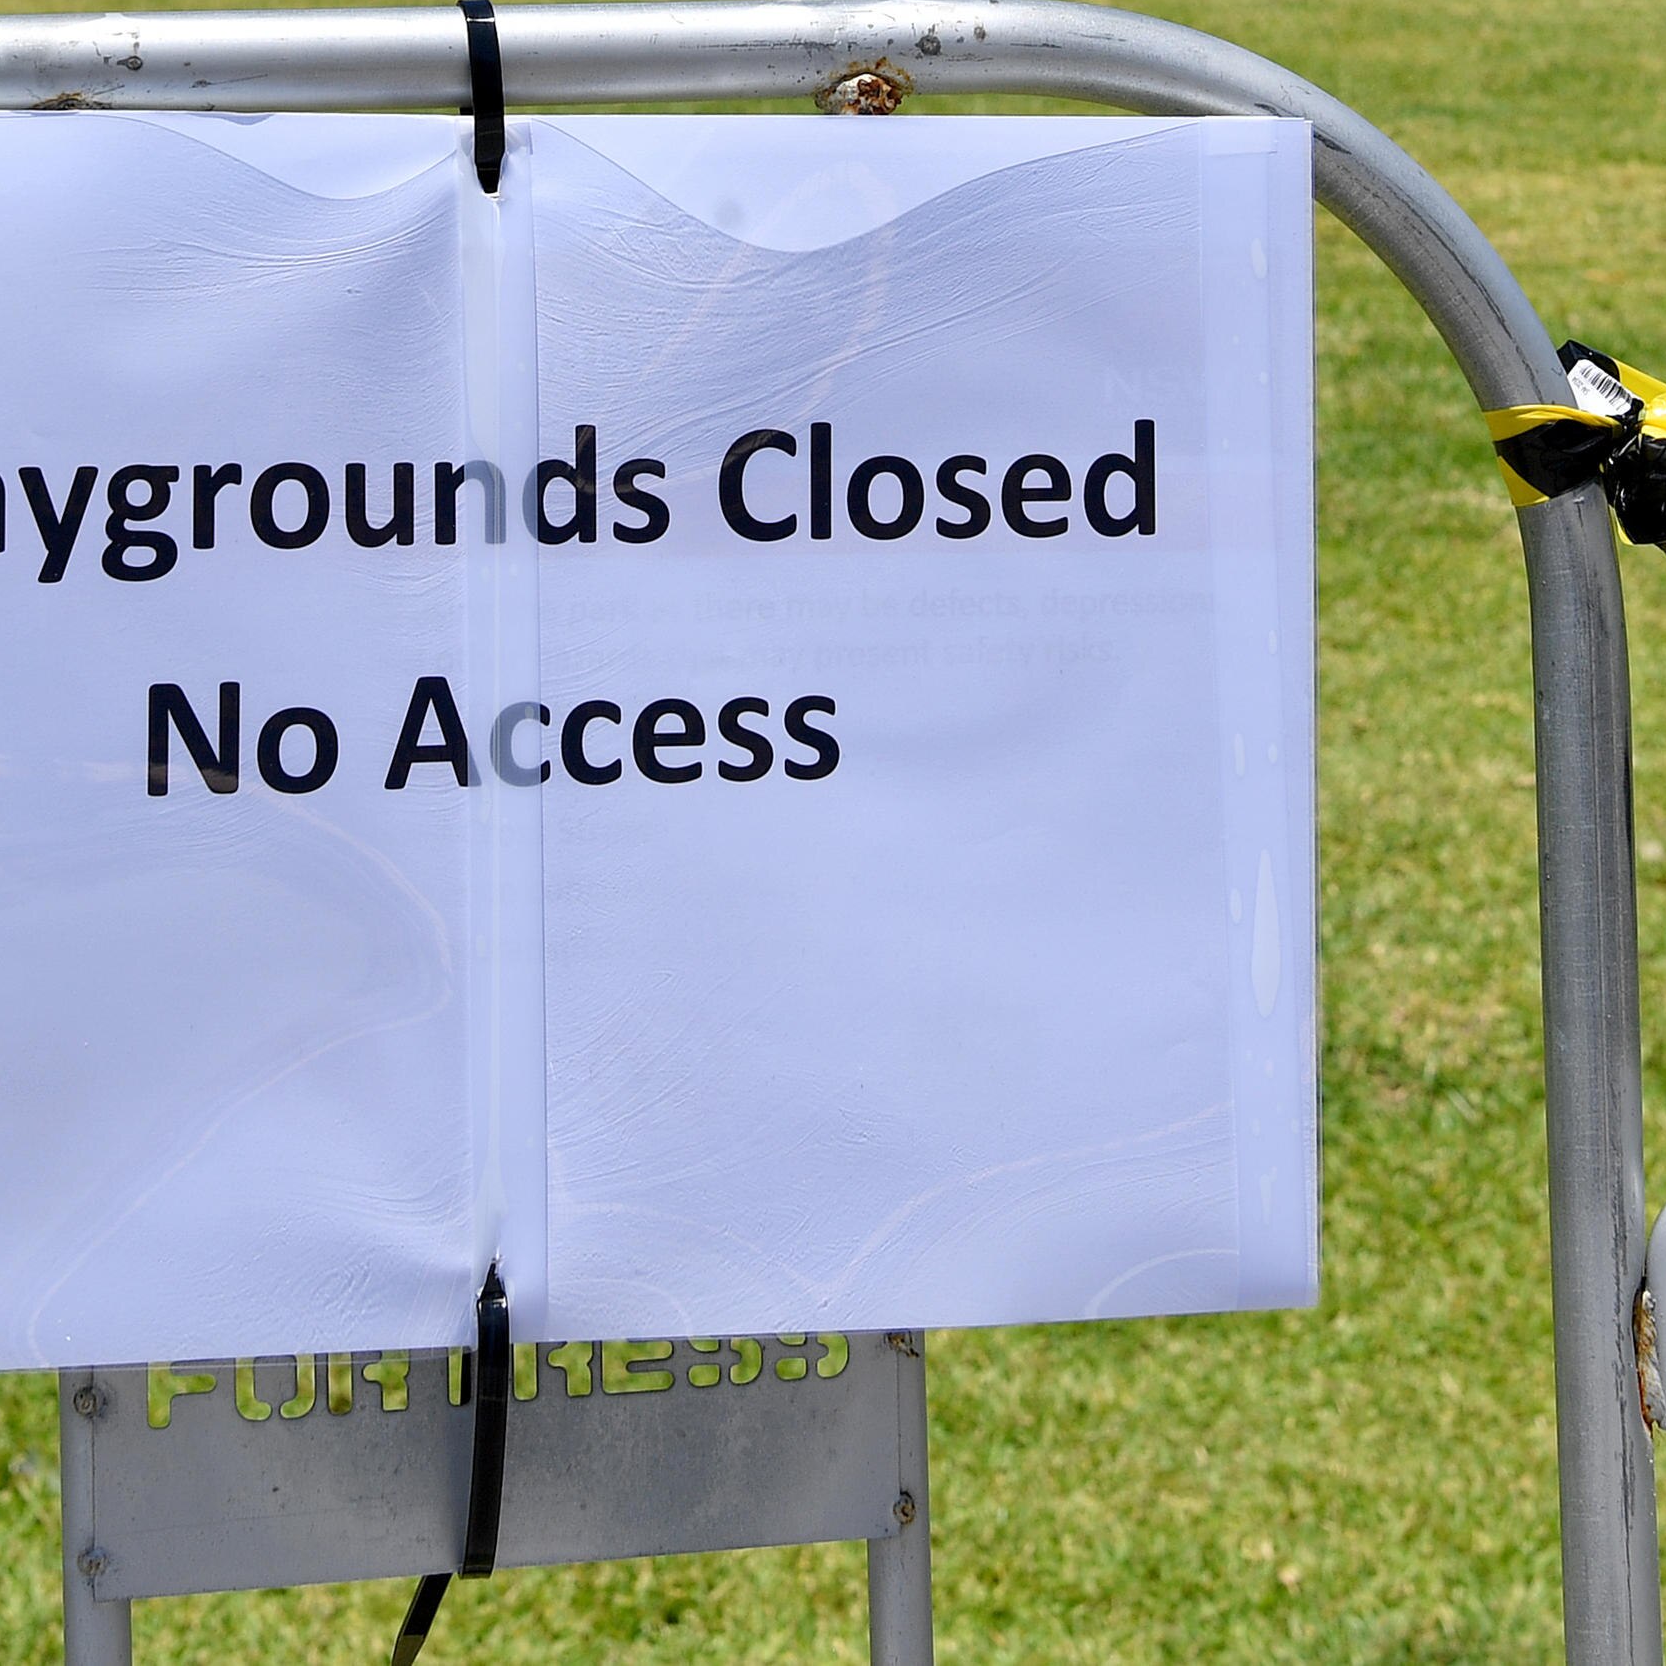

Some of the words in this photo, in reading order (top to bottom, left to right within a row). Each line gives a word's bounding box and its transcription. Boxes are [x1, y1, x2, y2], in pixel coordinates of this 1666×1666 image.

[718, 418, 1156, 543] Closed
[147, 681, 339, 797] No
[384, 675, 840, 791] Access
